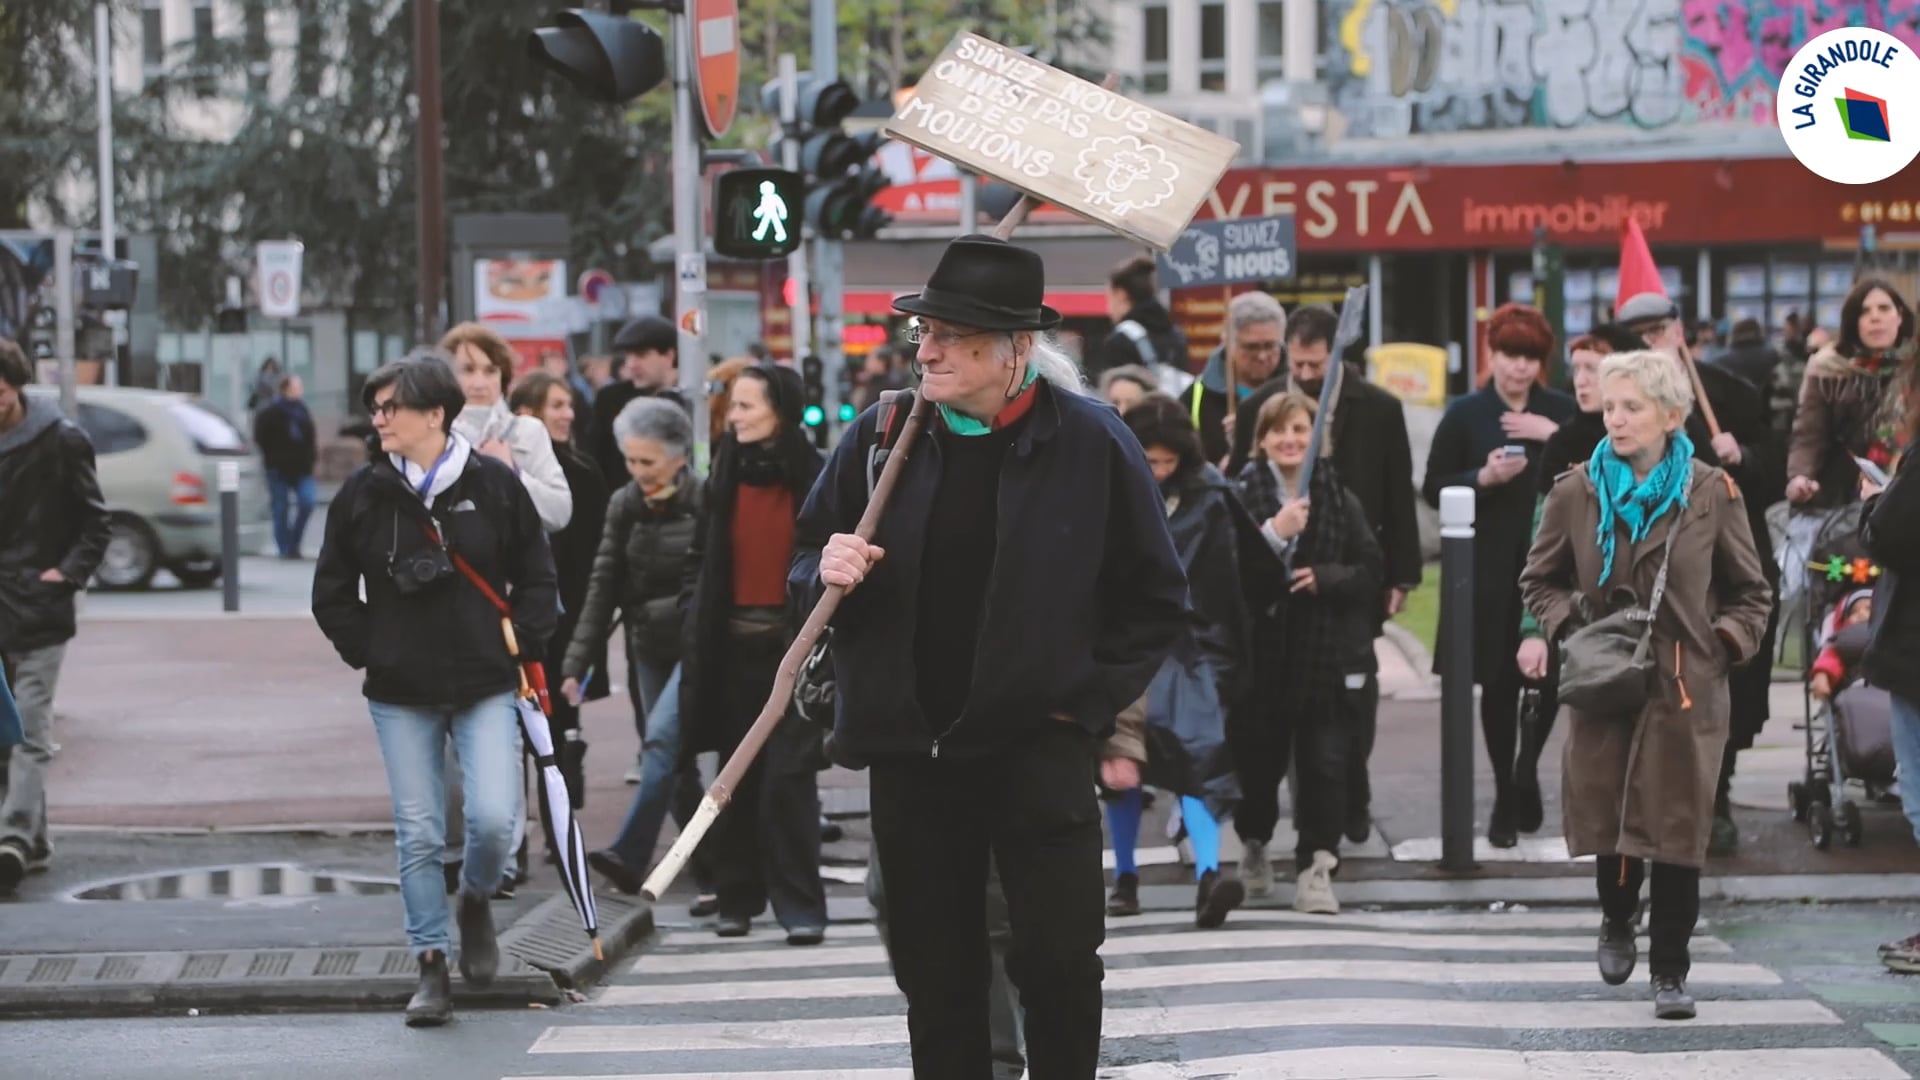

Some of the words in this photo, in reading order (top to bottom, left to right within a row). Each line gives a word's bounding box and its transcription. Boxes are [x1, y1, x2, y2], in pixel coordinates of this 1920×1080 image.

[958, 94, 1029, 135] DES
[1032, 99, 1091, 139] PAS
[1058, 81, 1152, 133] NOUS
[898, 97, 1055, 177] MOUTONS
[1223, 247, 1290, 279] NOUS
